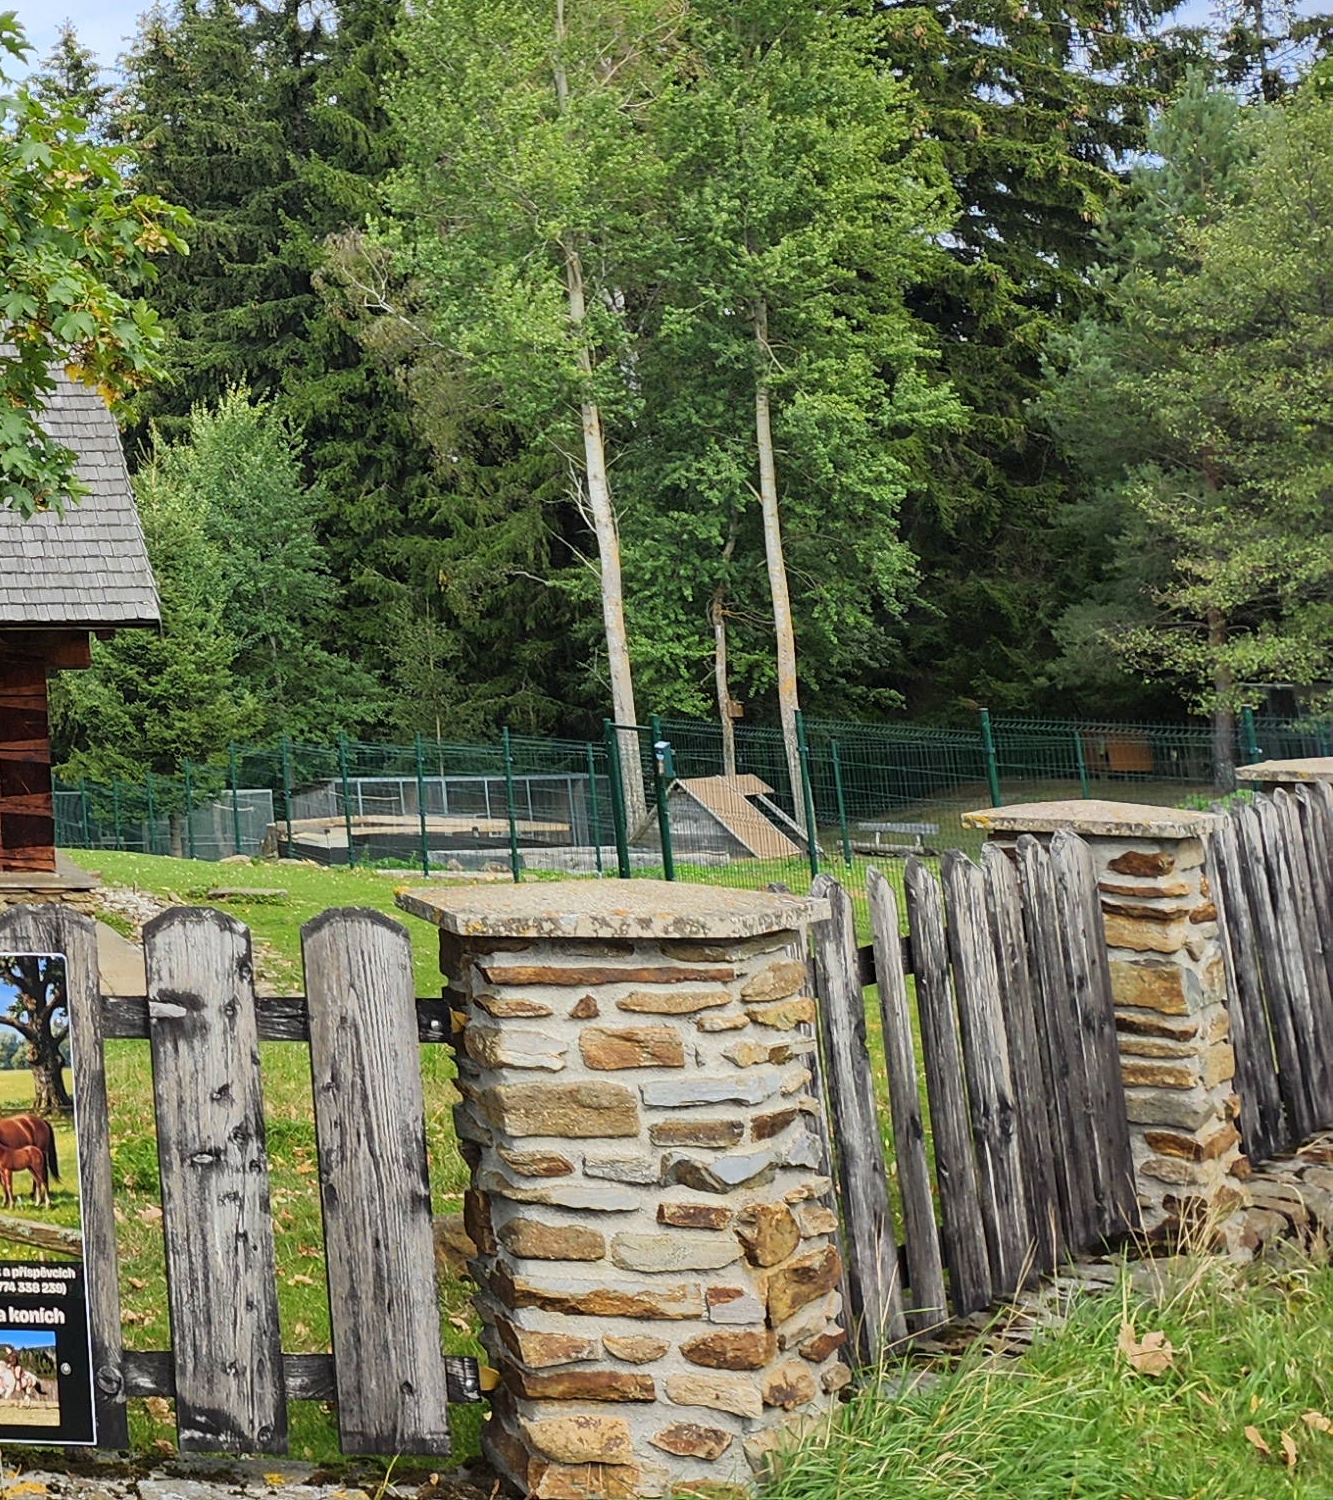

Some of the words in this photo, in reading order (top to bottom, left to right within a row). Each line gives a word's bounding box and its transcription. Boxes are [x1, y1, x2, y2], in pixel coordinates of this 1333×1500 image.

[2, 1267, 11, 1278] a
[11, 1265, 76, 1280] příspěvcích
[17, 1281, 41, 1293] 338
[41, 1282, 67, 1296] 239)
[8, 1305, 66, 1325] koních
